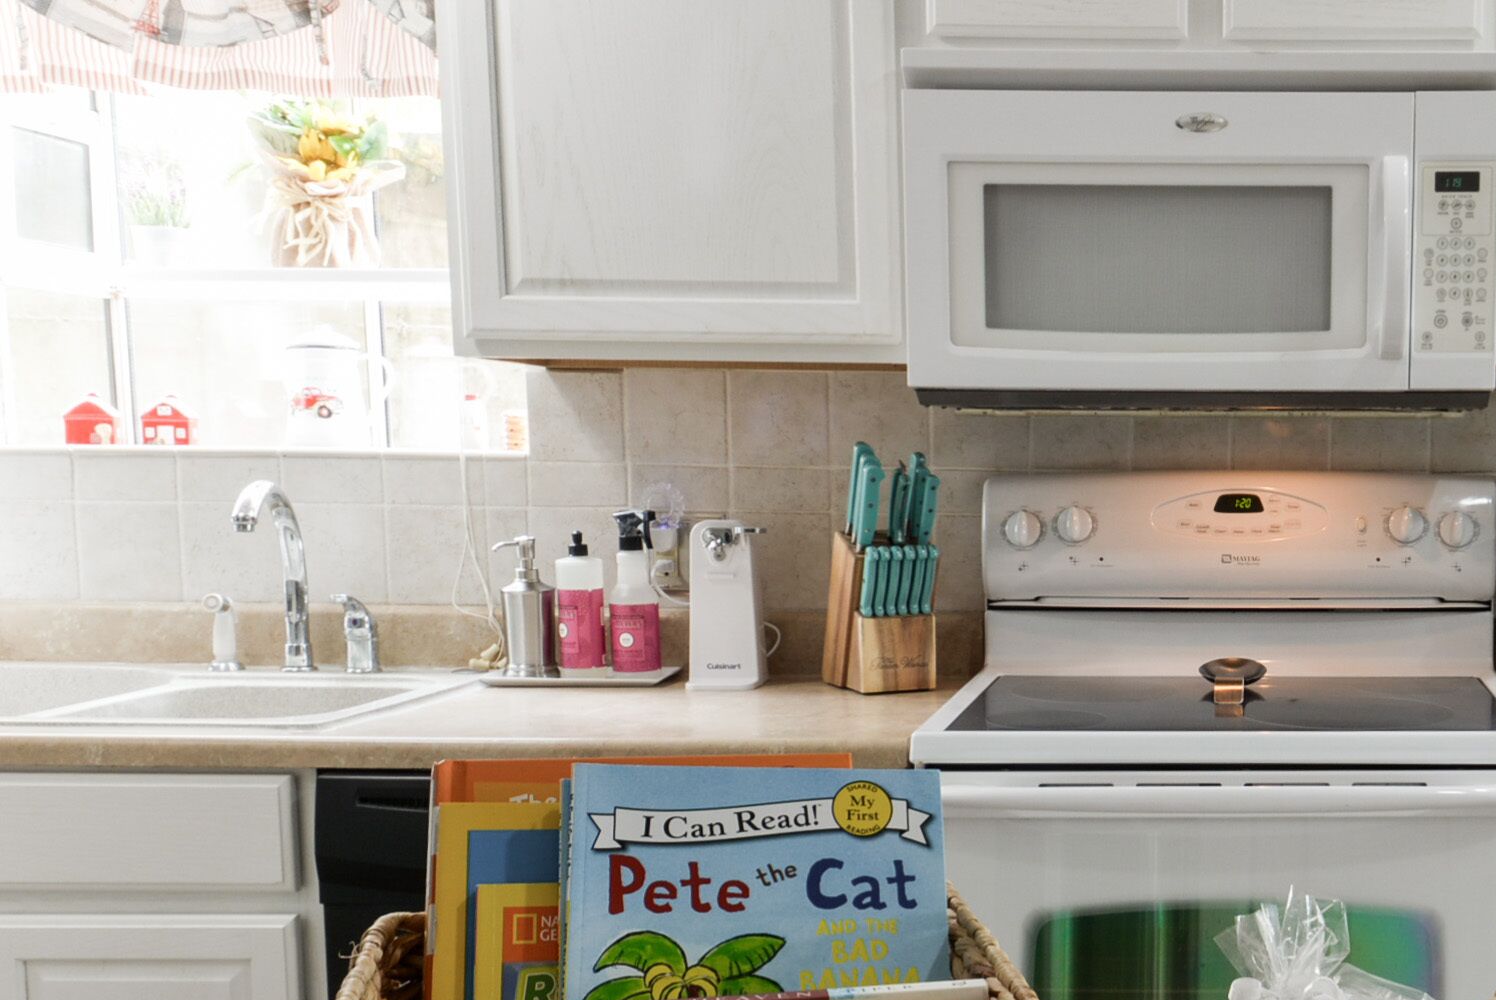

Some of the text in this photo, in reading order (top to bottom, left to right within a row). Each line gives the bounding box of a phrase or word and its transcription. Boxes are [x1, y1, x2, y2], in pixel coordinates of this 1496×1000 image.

[847, 809, 879, 820] First
[850, 795, 875, 809] My
[640, 803, 819, 839] I Can Read!
[608, 854, 918, 915] Pete the Cat
[816, 917, 899, 936] AND THE
[831, 938, 890, 964] BAD
[800, 965, 921, 991] BANANA
